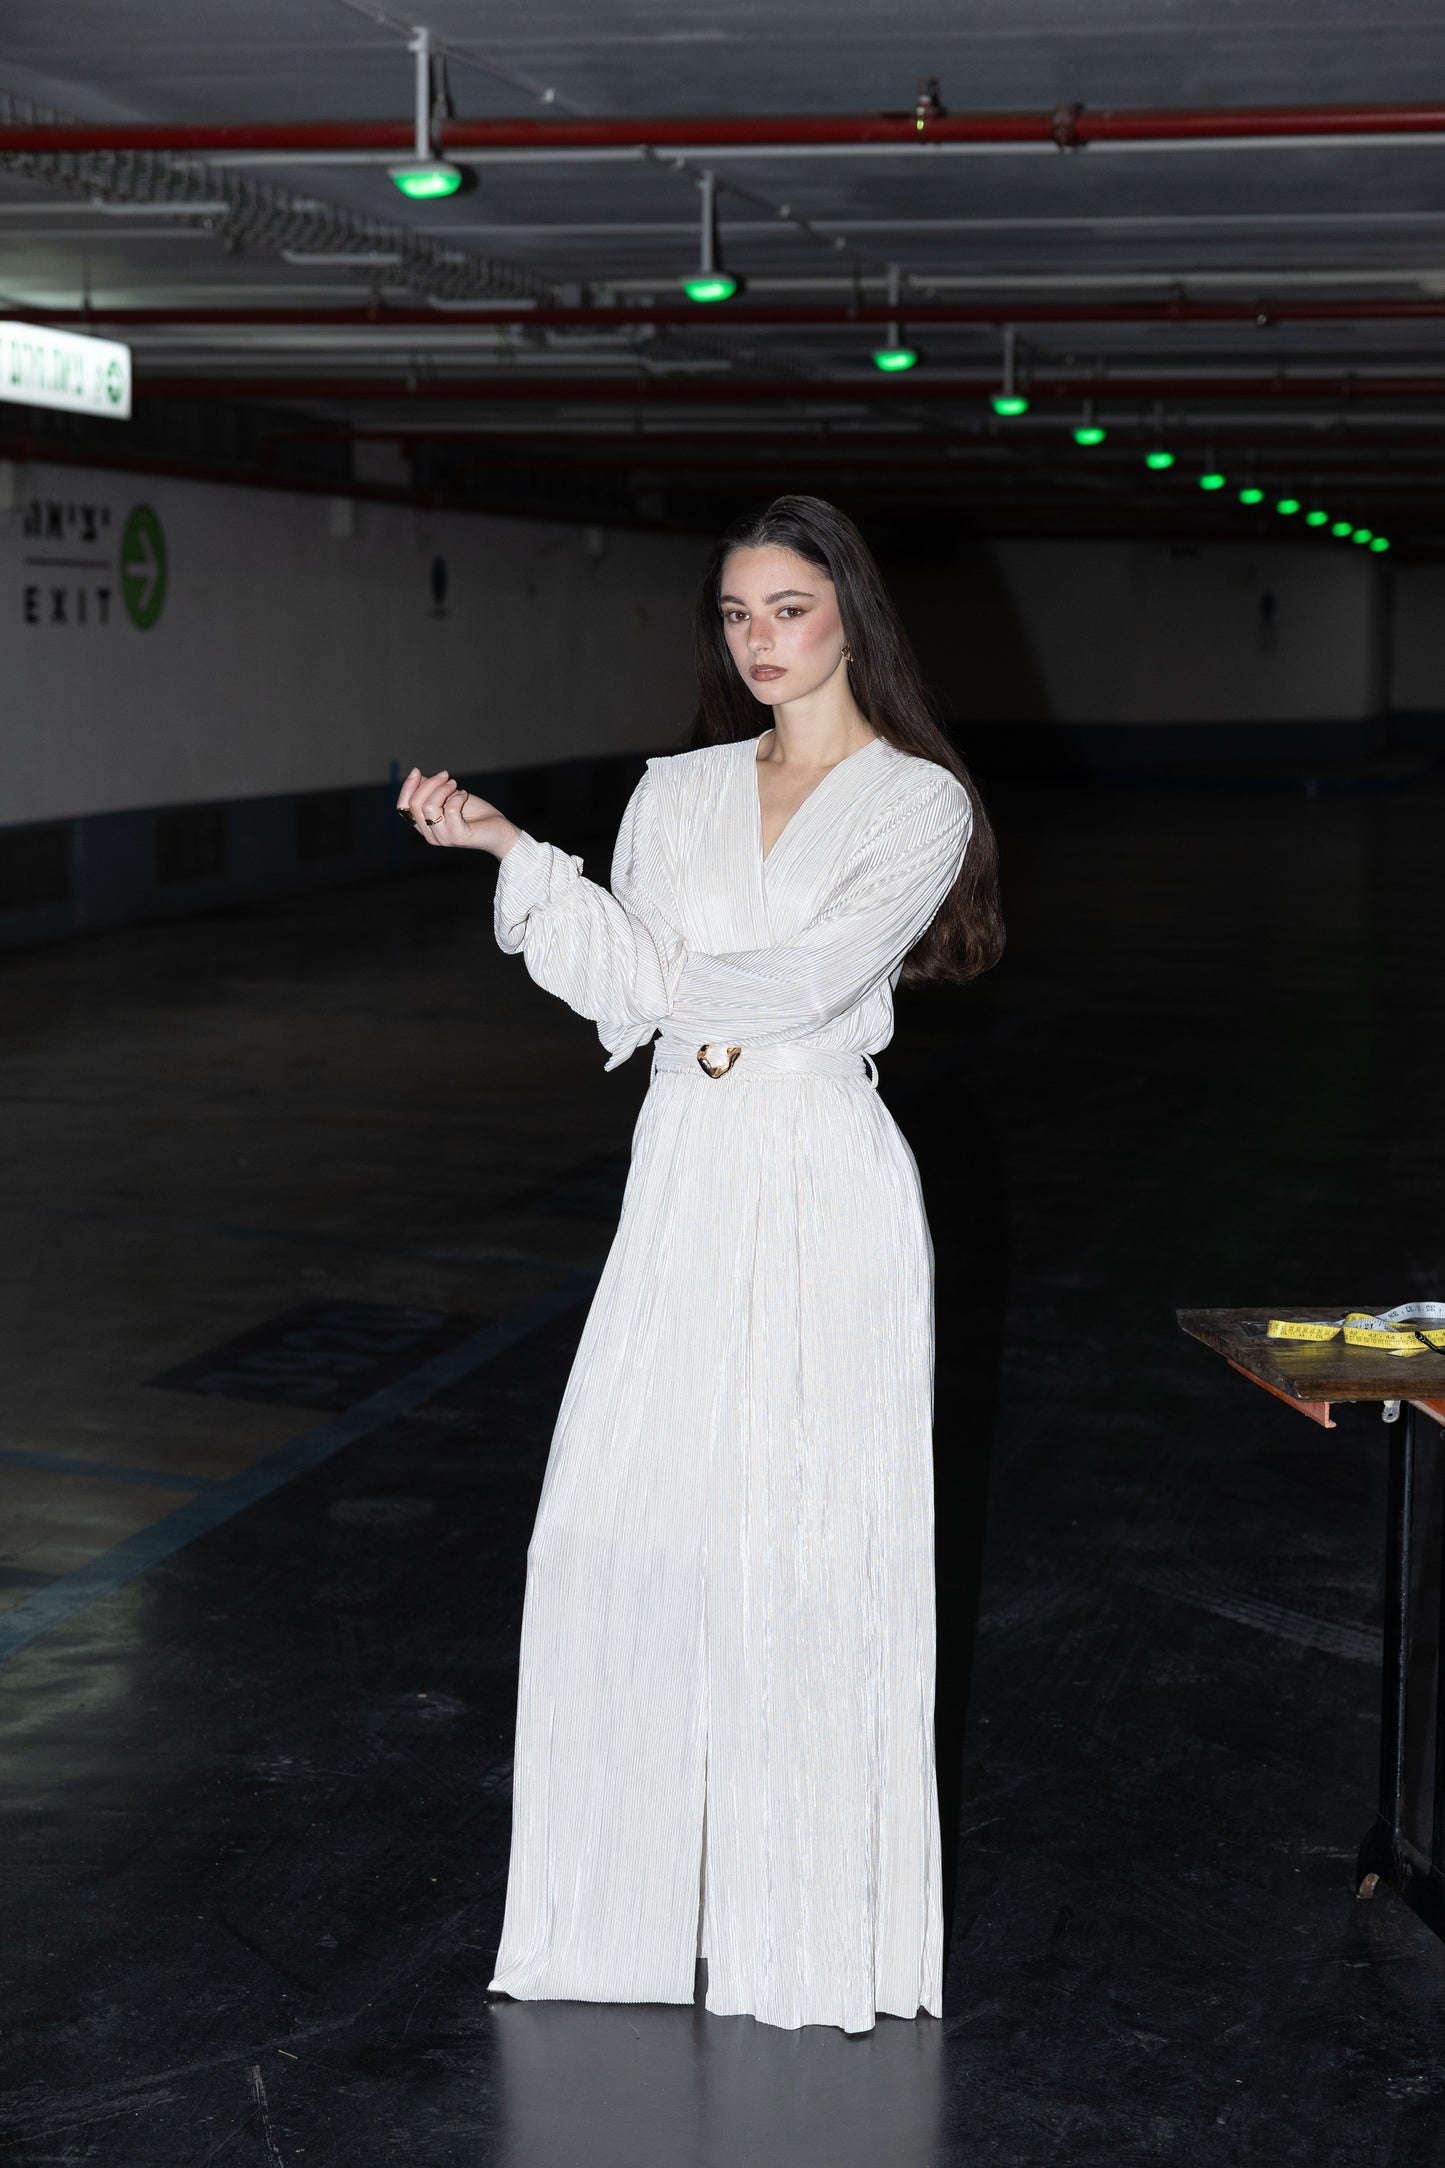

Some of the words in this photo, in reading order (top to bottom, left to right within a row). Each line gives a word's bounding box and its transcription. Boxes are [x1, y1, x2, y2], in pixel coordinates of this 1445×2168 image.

[23, 500, 111, 541] יציאה
[24, 585, 112, 625] EXIT
[193, 1307, 448, 1396] 3920
